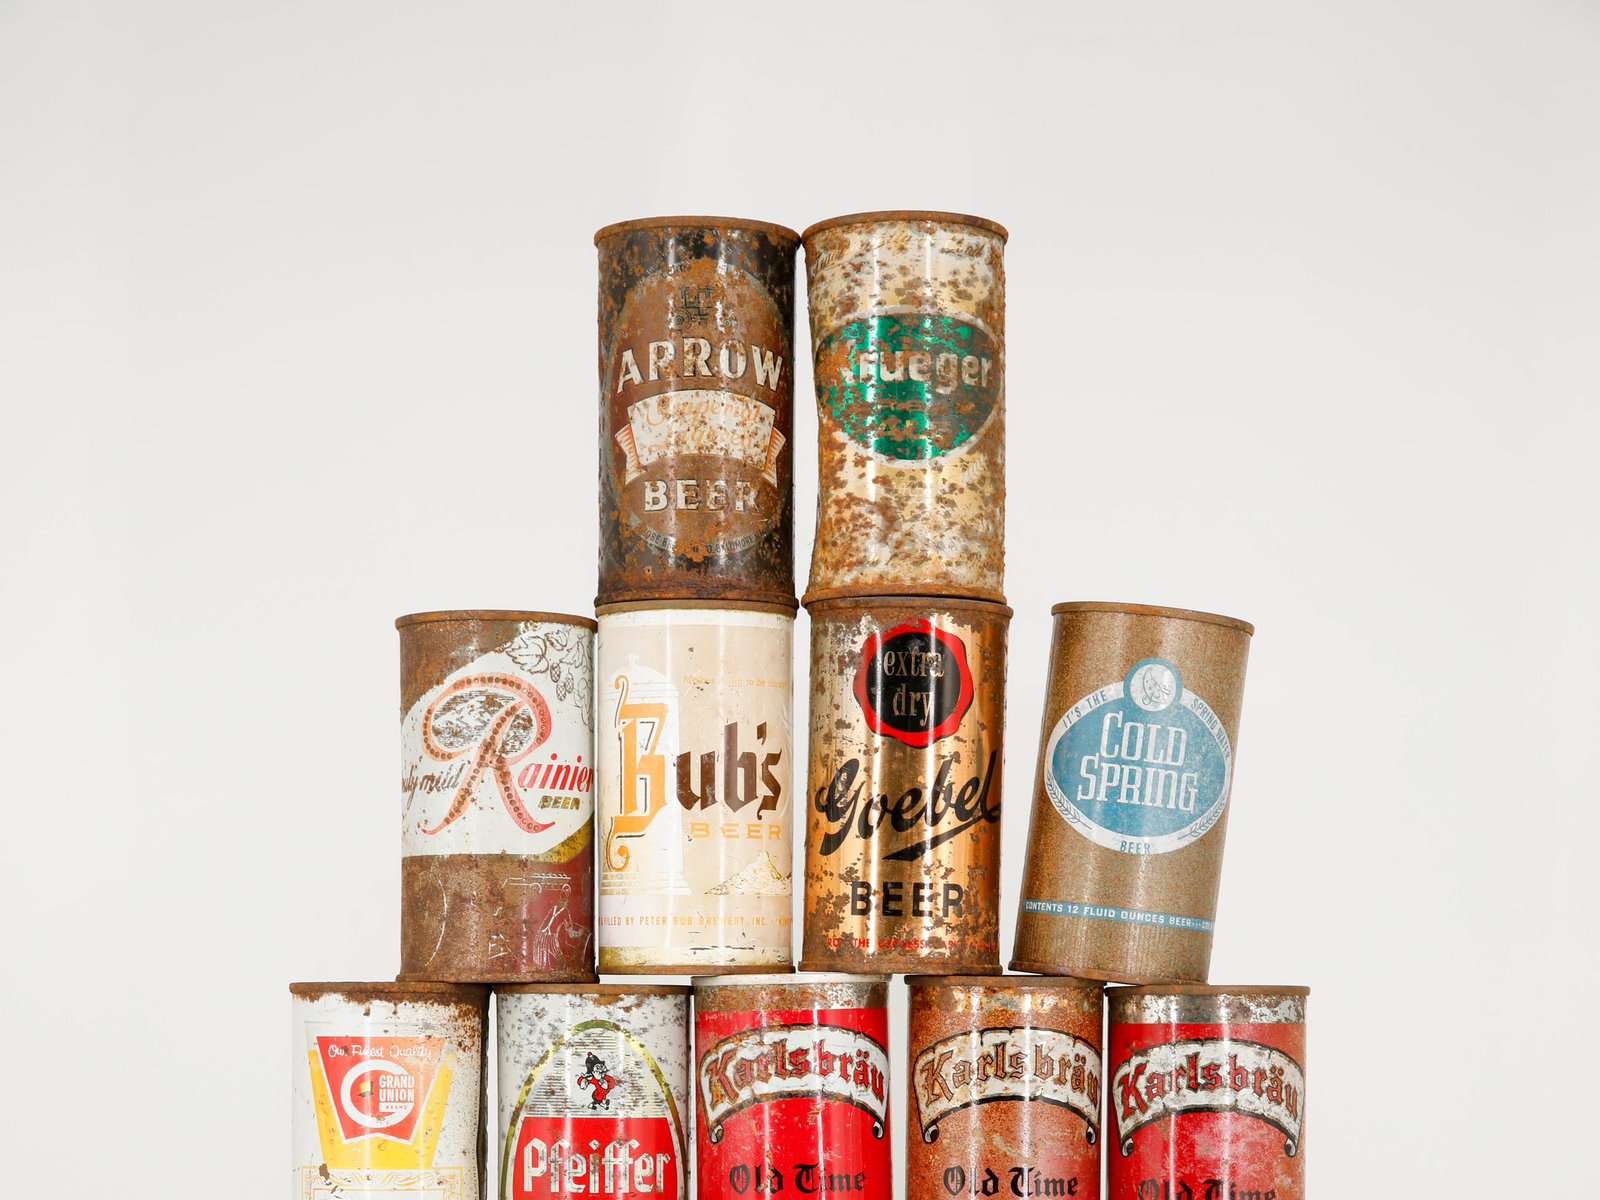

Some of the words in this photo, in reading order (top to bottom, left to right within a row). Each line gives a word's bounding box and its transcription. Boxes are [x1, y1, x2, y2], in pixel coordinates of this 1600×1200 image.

[616, 337, 783, 394] ARROW
[643, 479, 764, 512] BEER
[883, 649, 945, 679] extra
[892, 683, 934, 727] dry
[1062, 707, 1082, 729] IT'S
[1086, 690, 1107, 710] THE
[1189, 697, 1218, 731] SPRING
[1100, 710, 1188, 767] COLD
[1076, 752, 1199, 814] SPRING
[538, 795, 581, 811] BEER
[815, 750, 1002, 861] Goebel
[690, 822, 782, 841] BEER
[1119, 840, 1151, 855] BEER
[850, 881, 965, 918] BEER
[1025, 901, 1063, 913] CONTENTS
[1067, 904, 1079, 914] 12
[1083, 906, 1116, 918] FLUID
[1120, 910, 1165, 925] OUNCES
[625, 916, 635, 926] BY
[639, 916, 668, 926] PETER
[672, 916, 693, 926] BUB
[379, 1075, 414, 1089] GRAND
[922, 1041, 1100, 1111] Karlsbräu
[1117, 1051, 1299, 1121] Karlsbräu
[379, 1088, 414, 1102] UNION
[523, 1137, 670, 1194] Pfeiffer
[729, 1163, 784, 1195] Old
[793, 1163, 866, 1195] Time
[943, 1164, 1000, 1197] Old
[1008, 1166, 1079, 1198] Time
